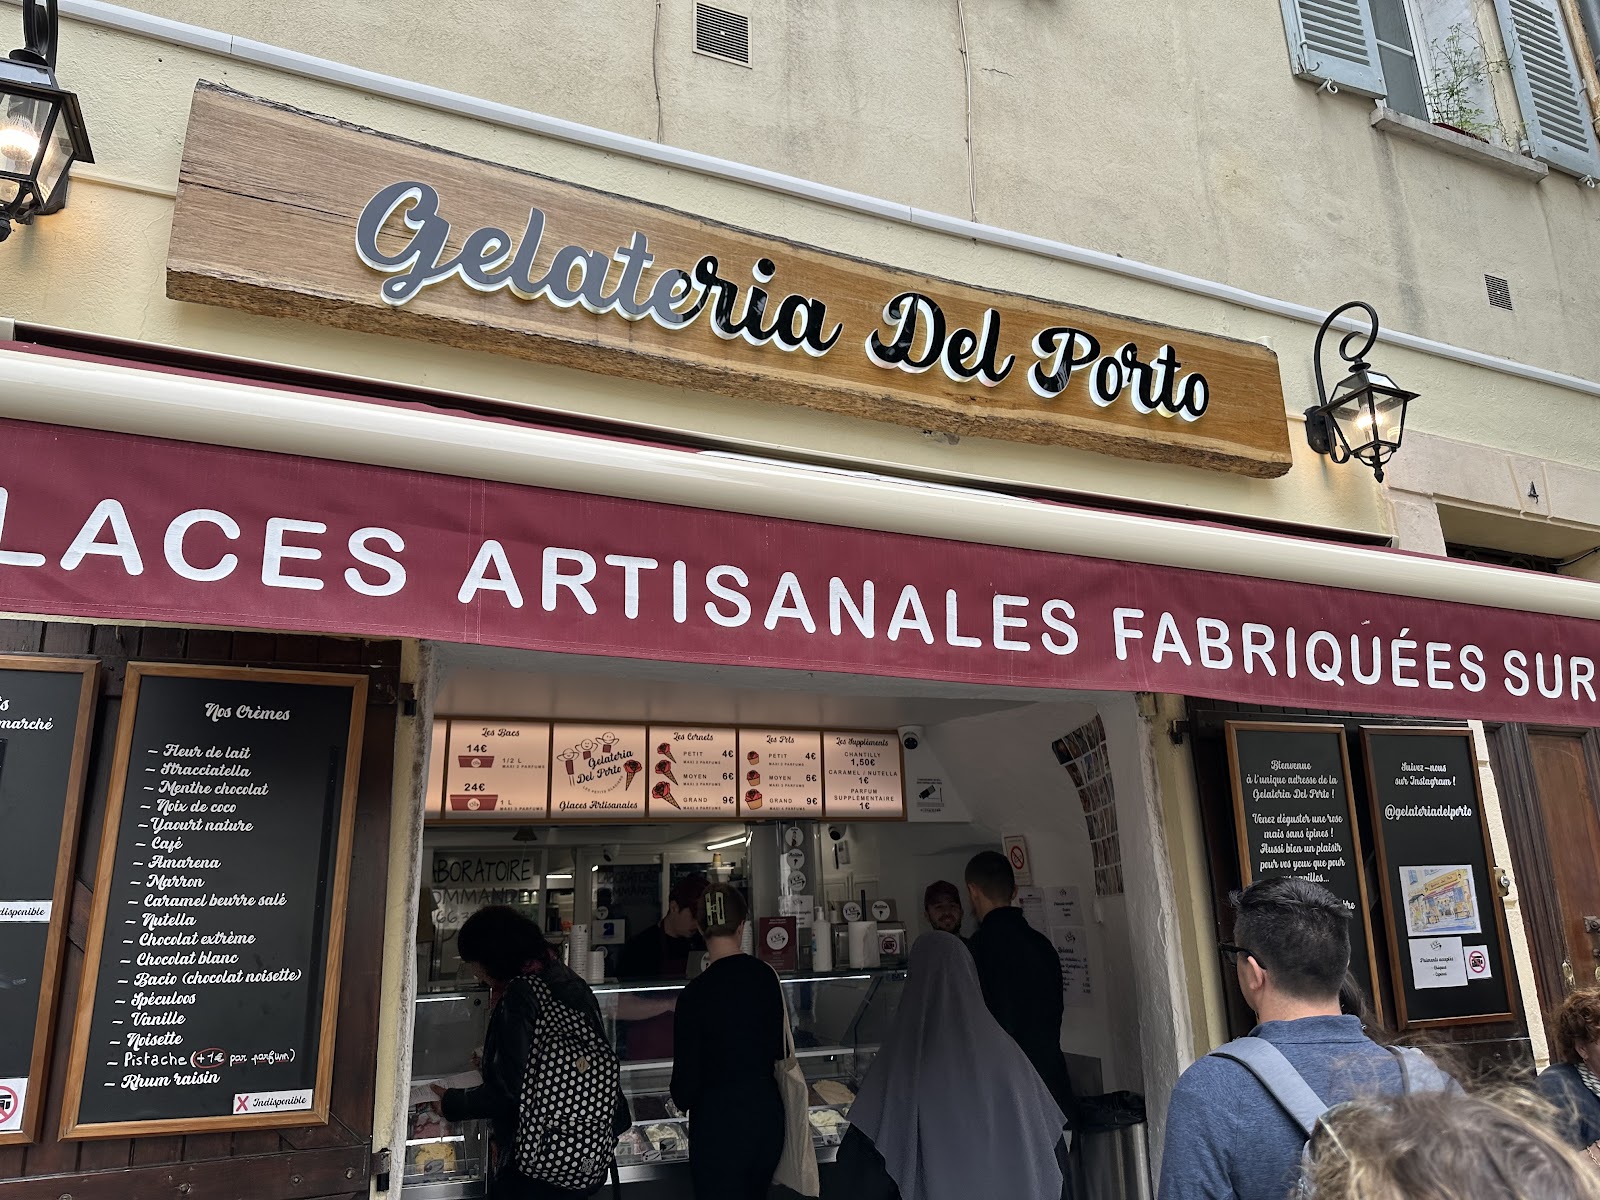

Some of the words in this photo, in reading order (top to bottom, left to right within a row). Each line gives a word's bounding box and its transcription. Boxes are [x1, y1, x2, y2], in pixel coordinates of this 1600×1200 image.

[355, 181, 844, 358] Gelateria
[865, 292, 1015, 388] Del
[1027, 326, 1209, 422] Porto
[458, 539, 1078, 655] ARTISANALES
[1112, 607, 1486, 692] FABRIQUÉES
[1504, 650, 1597, 702] SUR
[205, 703, 231, 722] Nos
[236, 705, 290, 720] Crèmes
[482, 728, 495, 737] Les
[497, 728, 520, 737] Bacs
[673, 732, 685, 741] Les
[687, 733, 714, 741] Cornets
[766, 735, 777, 744] Les
[466, 744, 487, 753] 14€
[836, 737, 846, 746] Les
[163, 743, 203, 757] Fleur
[205, 746, 223, 758] de
[225, 747, 251, 759] lait
[805, 752, 816, 760] 4€
[588, 749, 634, 770] Gelateria
[851, 758, 875, 767] 1,50€
[1271, 759, 1312, 771] Bienvenue
[160, 762, 251, 777] Stracciatella
[577, 771, 594, 784] Del
[596, 765, 622, 778] Porto
[722, 772, 734, 780] 6€
[806, 774, 817, 782] 6€
[1246, 774, 1253, 784] à
[1254, 774, 1286, 787] l'unique
[1288, 774, 1317, 785] adresse
[1318, 775, 1328, 785] de
[1329, 775, 1338, 785] la
[1394, 776, 1409, 786] sur
[1409, 775, 1452, 788] Instagram
[158, 780, 212, 796] Menthe
[214, 782, 269, 795] chocolat
[464, 783, 486, 791] 24€
[722, 796, 734, 804] 9€
[806, 797, 818, 805] 9€
[1252, 788, 1292, 802] Gelateria
[1292, 788, 1308, 799] Del
[1309, 788, 1330, 799] Porto
[157, 799, 188, 816] Noix
[190, 800, 208, 812] de
[211, 804, 237, 813] coco
[559, 801, 587, 811] Glaces
[589, 800, 638, 809] Artisanales
[1384, 804, 1472, 820] @gelateriadelporto
[150, 817, 203, 834] Yaourt
[205, 819, 254, 832] nature
[1252, 813, 1275, 824] Venez
[1277, 813, 1311, 826] déguster
[1311, 815, 1326, 823] une
[1326, 813, 1343, 823] rose
[1263, 829, 1284, 839] mais
[1285, 829, 1304, 839] sans
[1305, 828, 1329, 841] épines
[151, 836, 183, 853] Café
[1260, 842, 1285, 854] Aussi
[1285, 842, 1303, 853] bien
[1315, 842, 1342, 855] plaisir
[148, 855, 221, 868] Amarena
[1260, 859, 1279, 872] pour
[1279, 860, 1291, 869] vos
[1293, 859, 1312, 871] yeux
[1312, 859, 1327, 870] que
[1327, 857, 1346, 871] pour
[146, 874, 205, 890] Marron
[144, 894, 207, 907] Caramel
[209, 893, 256, 906] beurre
[258, 893, 287, 906] salé
[142, 913, 197, 931] Nutella
[139, 932, 199, 946] Chocolat
[136, 951, 196, 966] Chocolat
[198, 951, 239, 965] blanc
[133, 972, 177, 987] Bacio
[182, 970, 243, 985] (chocolat
[245, 969, 302, 983] noisette)
[130, 991, 196, 1010] Spéculoos
[131, 1011, 186, 1026] Vanille
[126, 1031, 183, 1051] Noisette
[124, 1052, 187, 1067] Pistache
[230, 1055, 247, 1066] par
[120, 1074, 171, 1090] Rhum
[173, 1071, 220, 1085] raisin
[252, 1096, 306, 1109] Indisponible
